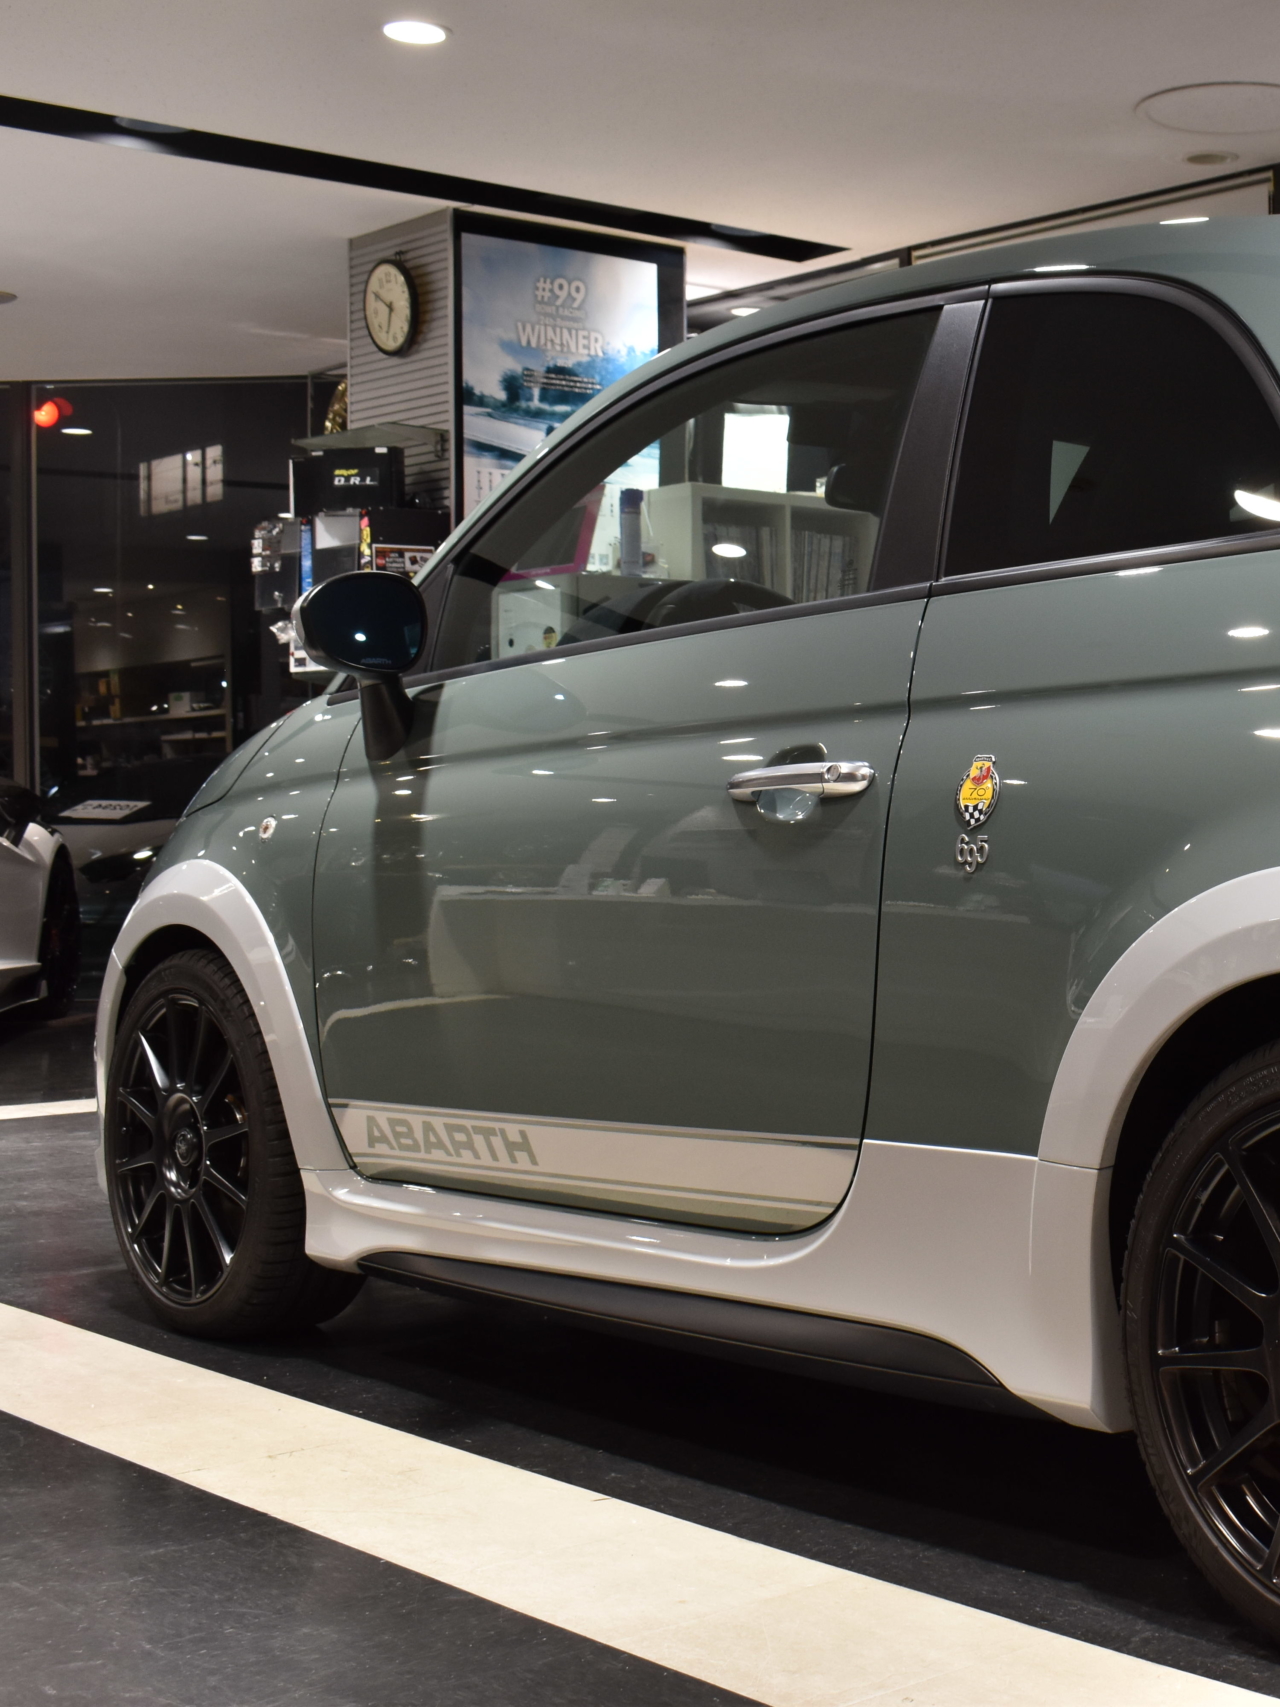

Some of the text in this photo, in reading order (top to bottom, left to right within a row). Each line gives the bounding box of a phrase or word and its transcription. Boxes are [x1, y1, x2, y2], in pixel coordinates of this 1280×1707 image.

[535, 277, 586, 308] #99
[517, 321, 604, 357] WINNER
[955, 833, 989, 874] 695
[365, 1114, 539, 1167] ABARTH
